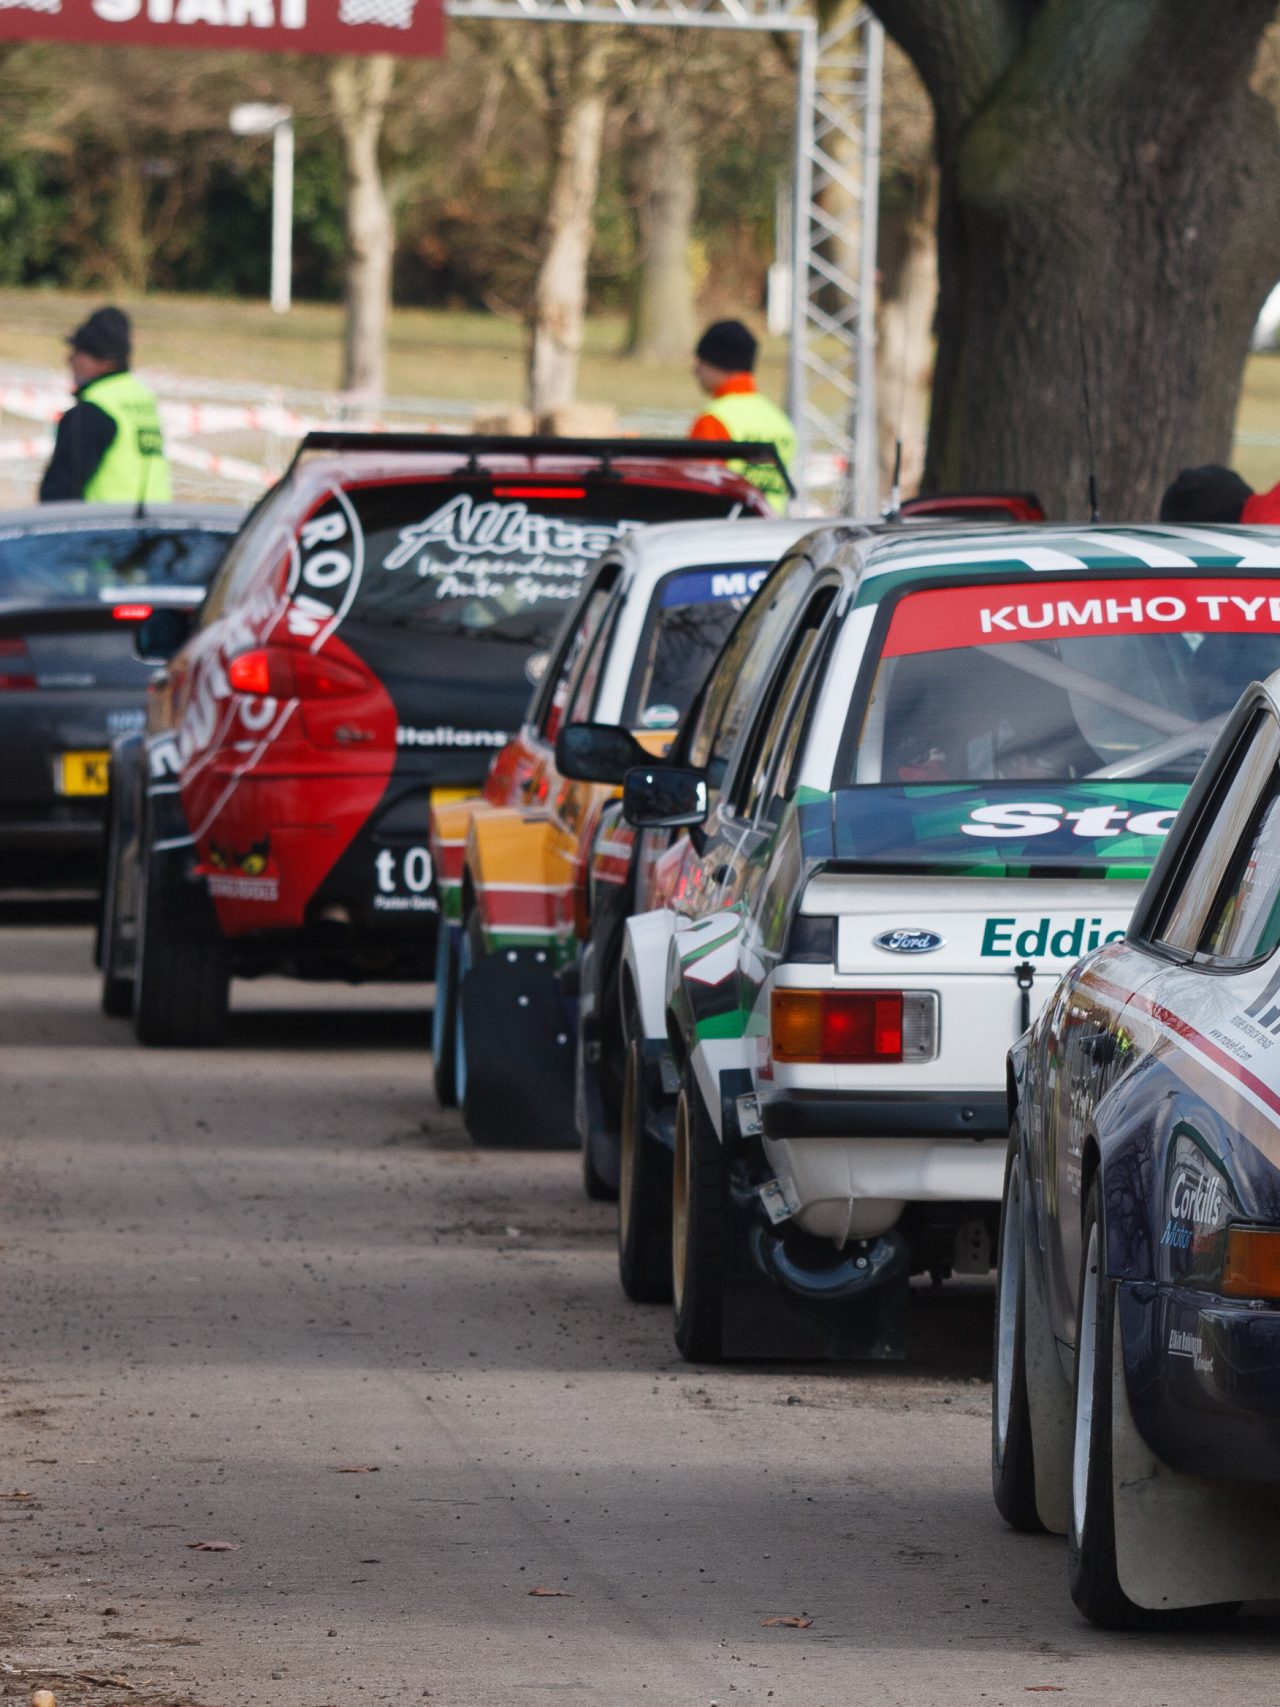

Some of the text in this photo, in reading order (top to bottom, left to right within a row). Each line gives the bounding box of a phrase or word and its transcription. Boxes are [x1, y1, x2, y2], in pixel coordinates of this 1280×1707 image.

[979, 596, 1186, 633] KUMHO
[888, 930, 931, 949] Ford
[1171, 1172, 1222, 1226] Corkills
